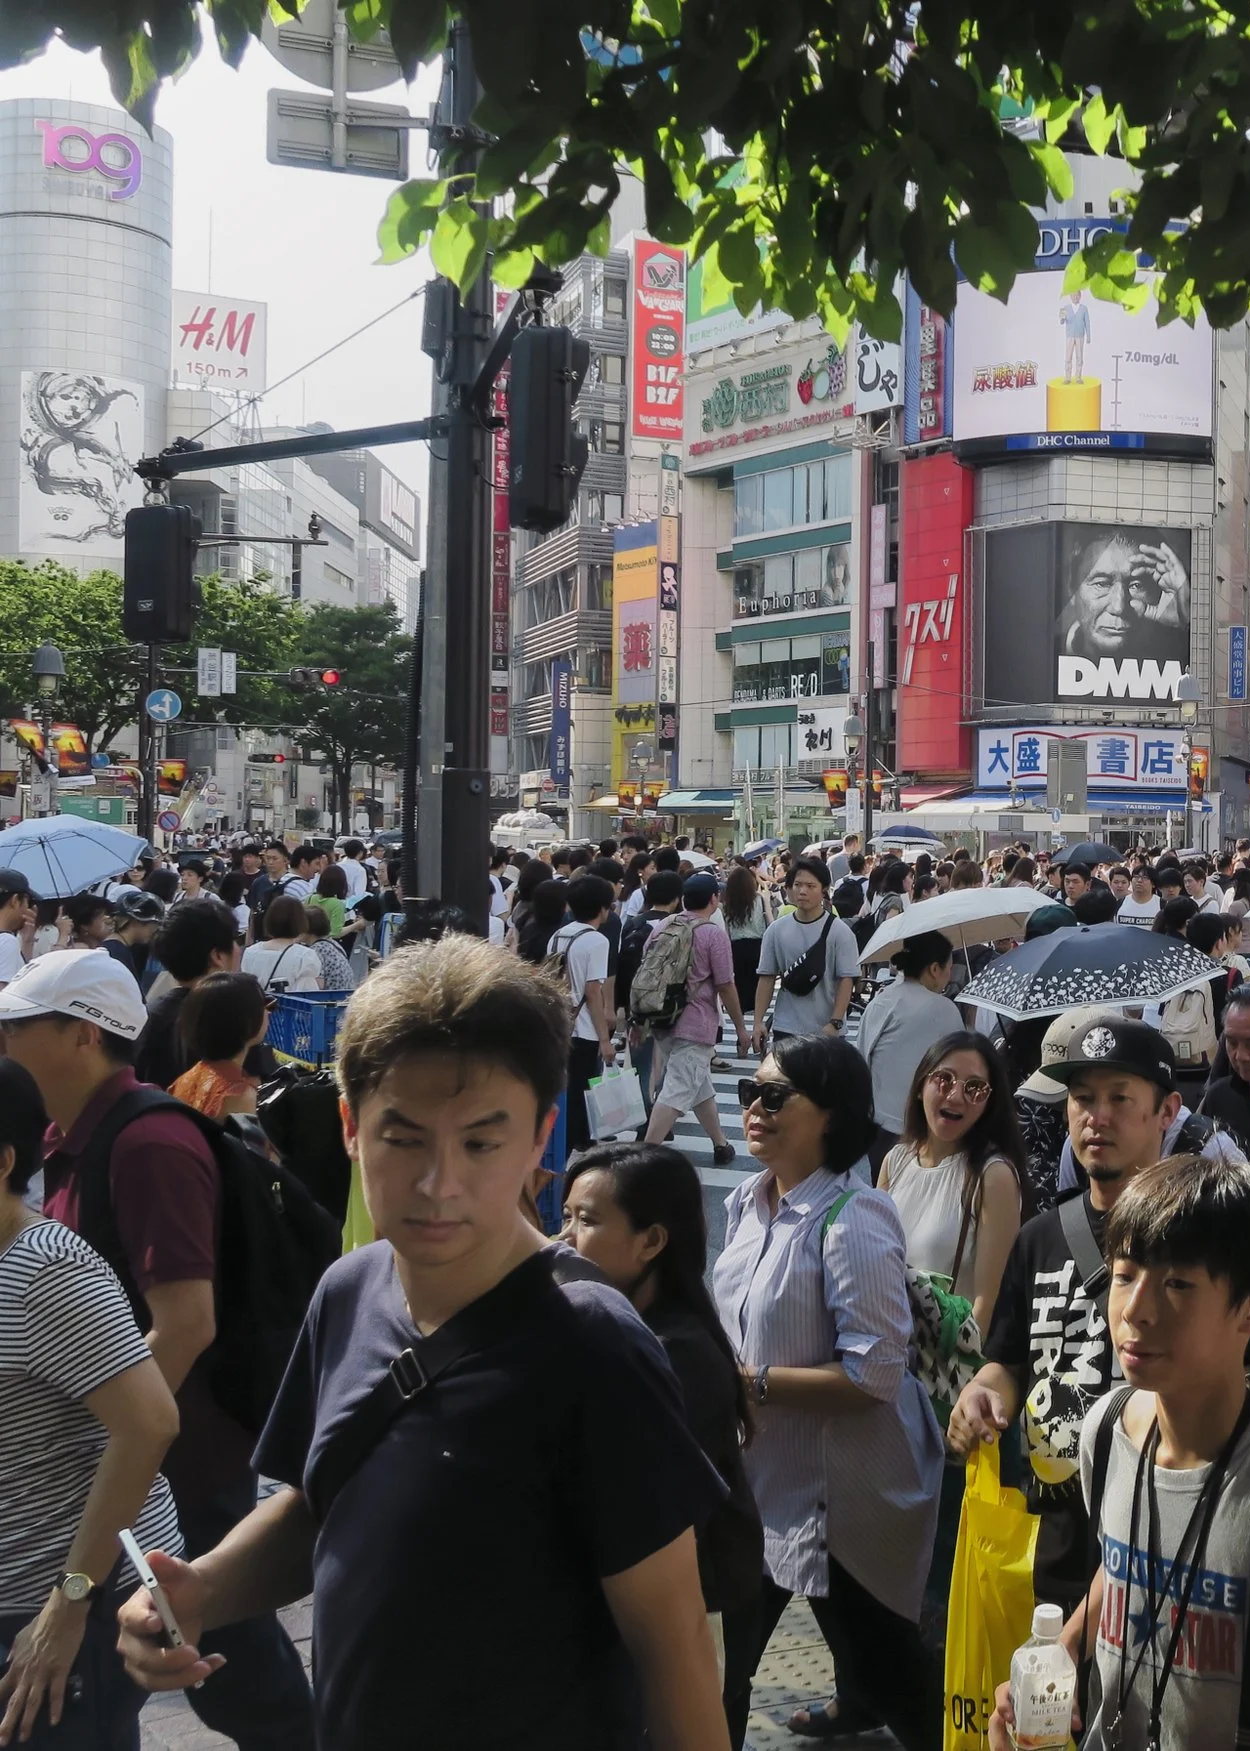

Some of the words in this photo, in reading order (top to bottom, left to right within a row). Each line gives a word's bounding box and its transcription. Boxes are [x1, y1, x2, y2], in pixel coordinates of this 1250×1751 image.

[35, 119, 142, 200] 109
[179, 306, 256, 357] H&M
[187, 361, 231, 378] 150m
[857, 323, 899, 402] じゃ
[1124, 351, 1180, 366] 7.0mg/dL
[646, 364, 679, 384] B1F
[973, 361, 1037, 393] 尿酸値
[646, 385, 679, 405] B2F
[1037, 435, 1063, 447] DHC
[1064, 434, 1111, 446] Channel
[739, 591, 817, 616] Euphoria
[623, 622, 652, 672] 薬
[1058, 655, 1184, 700] DMM
[1232, 631, 1244, 696] 大盛堂商事ビル
[559, 671, 567, 709] MIZUHO
[988, 738, 1176, 775] 大盛書店
[1124, 803, 1161, 811] TAISEIDO
[1119, 916, 1135, 924] SUPER
[69, 1000, 103, 1019] FG
[103, 1015, 137, 1033] TOUR
[1030, 1690, 1070, 1705] 午後の紅茶
[1031, 1708, 1051, 1717] MILK
[1054, 1705, 1067, 1714] TEA
